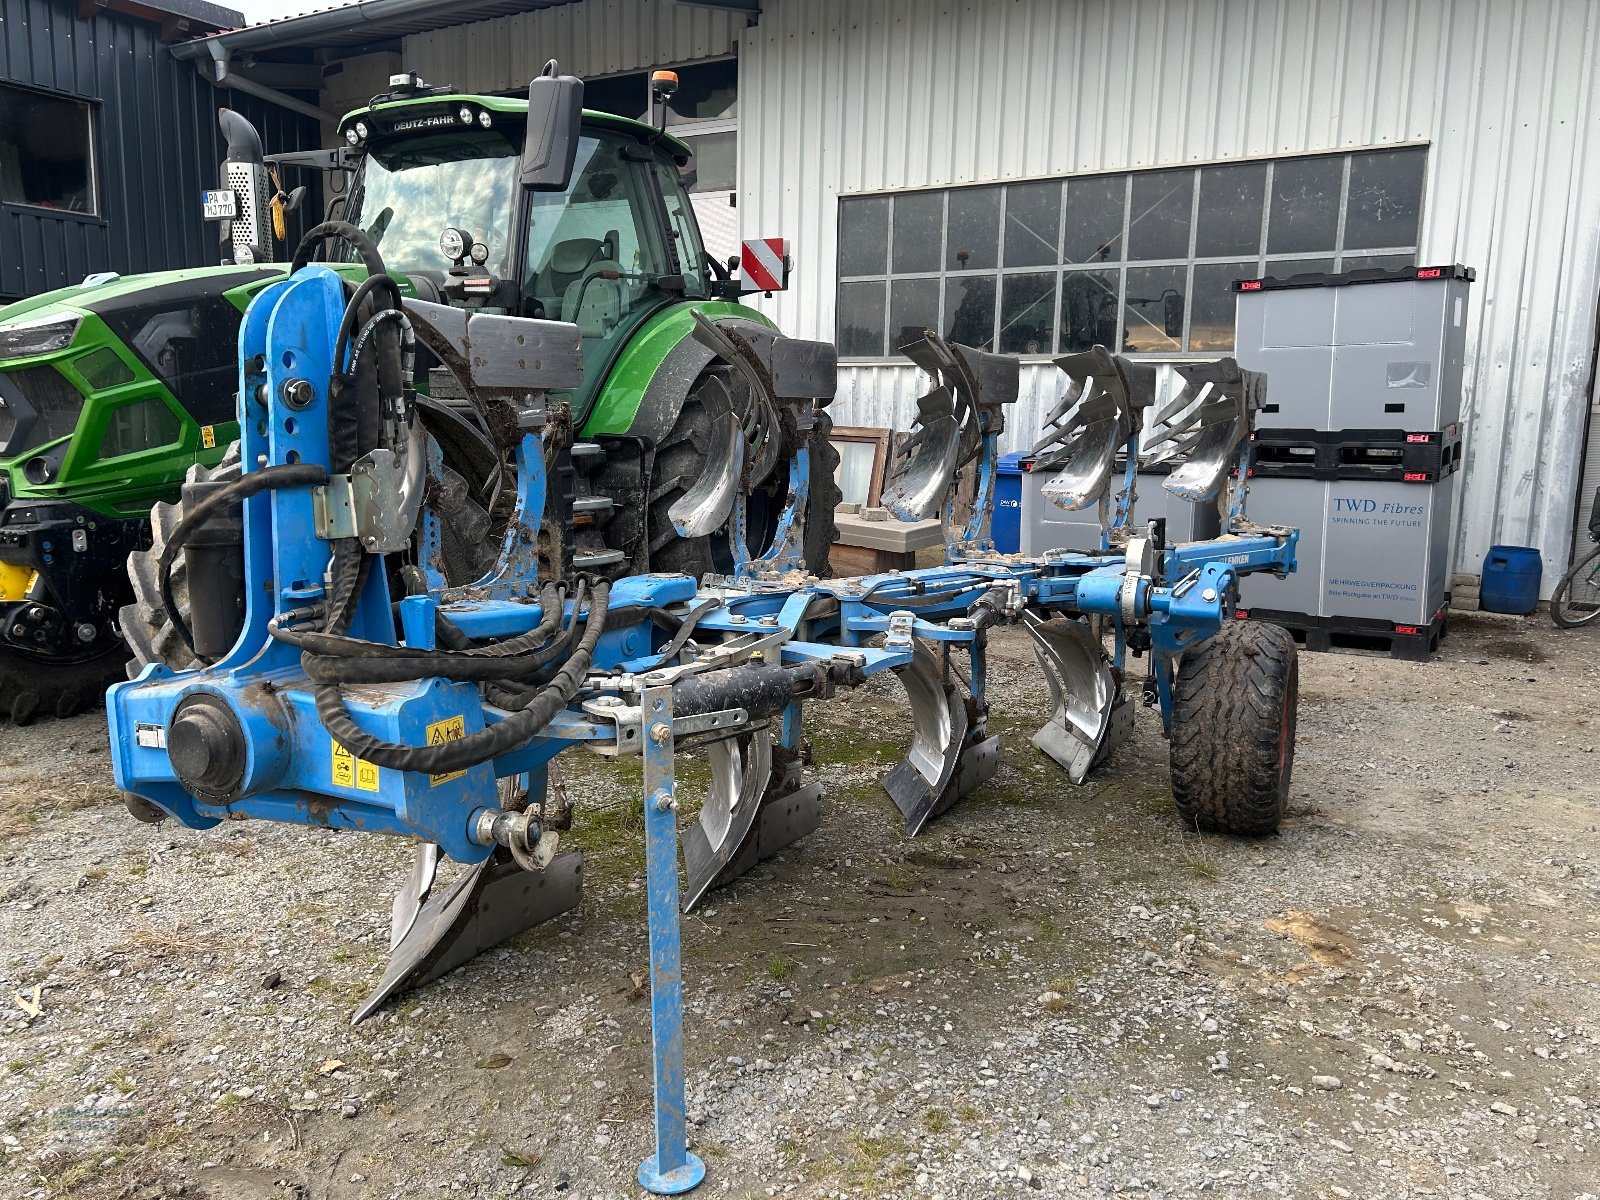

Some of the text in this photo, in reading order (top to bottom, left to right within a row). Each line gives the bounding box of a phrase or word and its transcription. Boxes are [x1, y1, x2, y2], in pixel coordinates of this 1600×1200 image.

[394, 115, 454, 131] DEUTZ-FAHR
[208, 192, 219, 204] PA
[1334, 499, 1424, 515] TWD Fibres
[1332, 517, 1422, 527] SPINNING THE FUTURE
[1328, 578, 1417, 591] MEHRWEGVERPACKUNG
